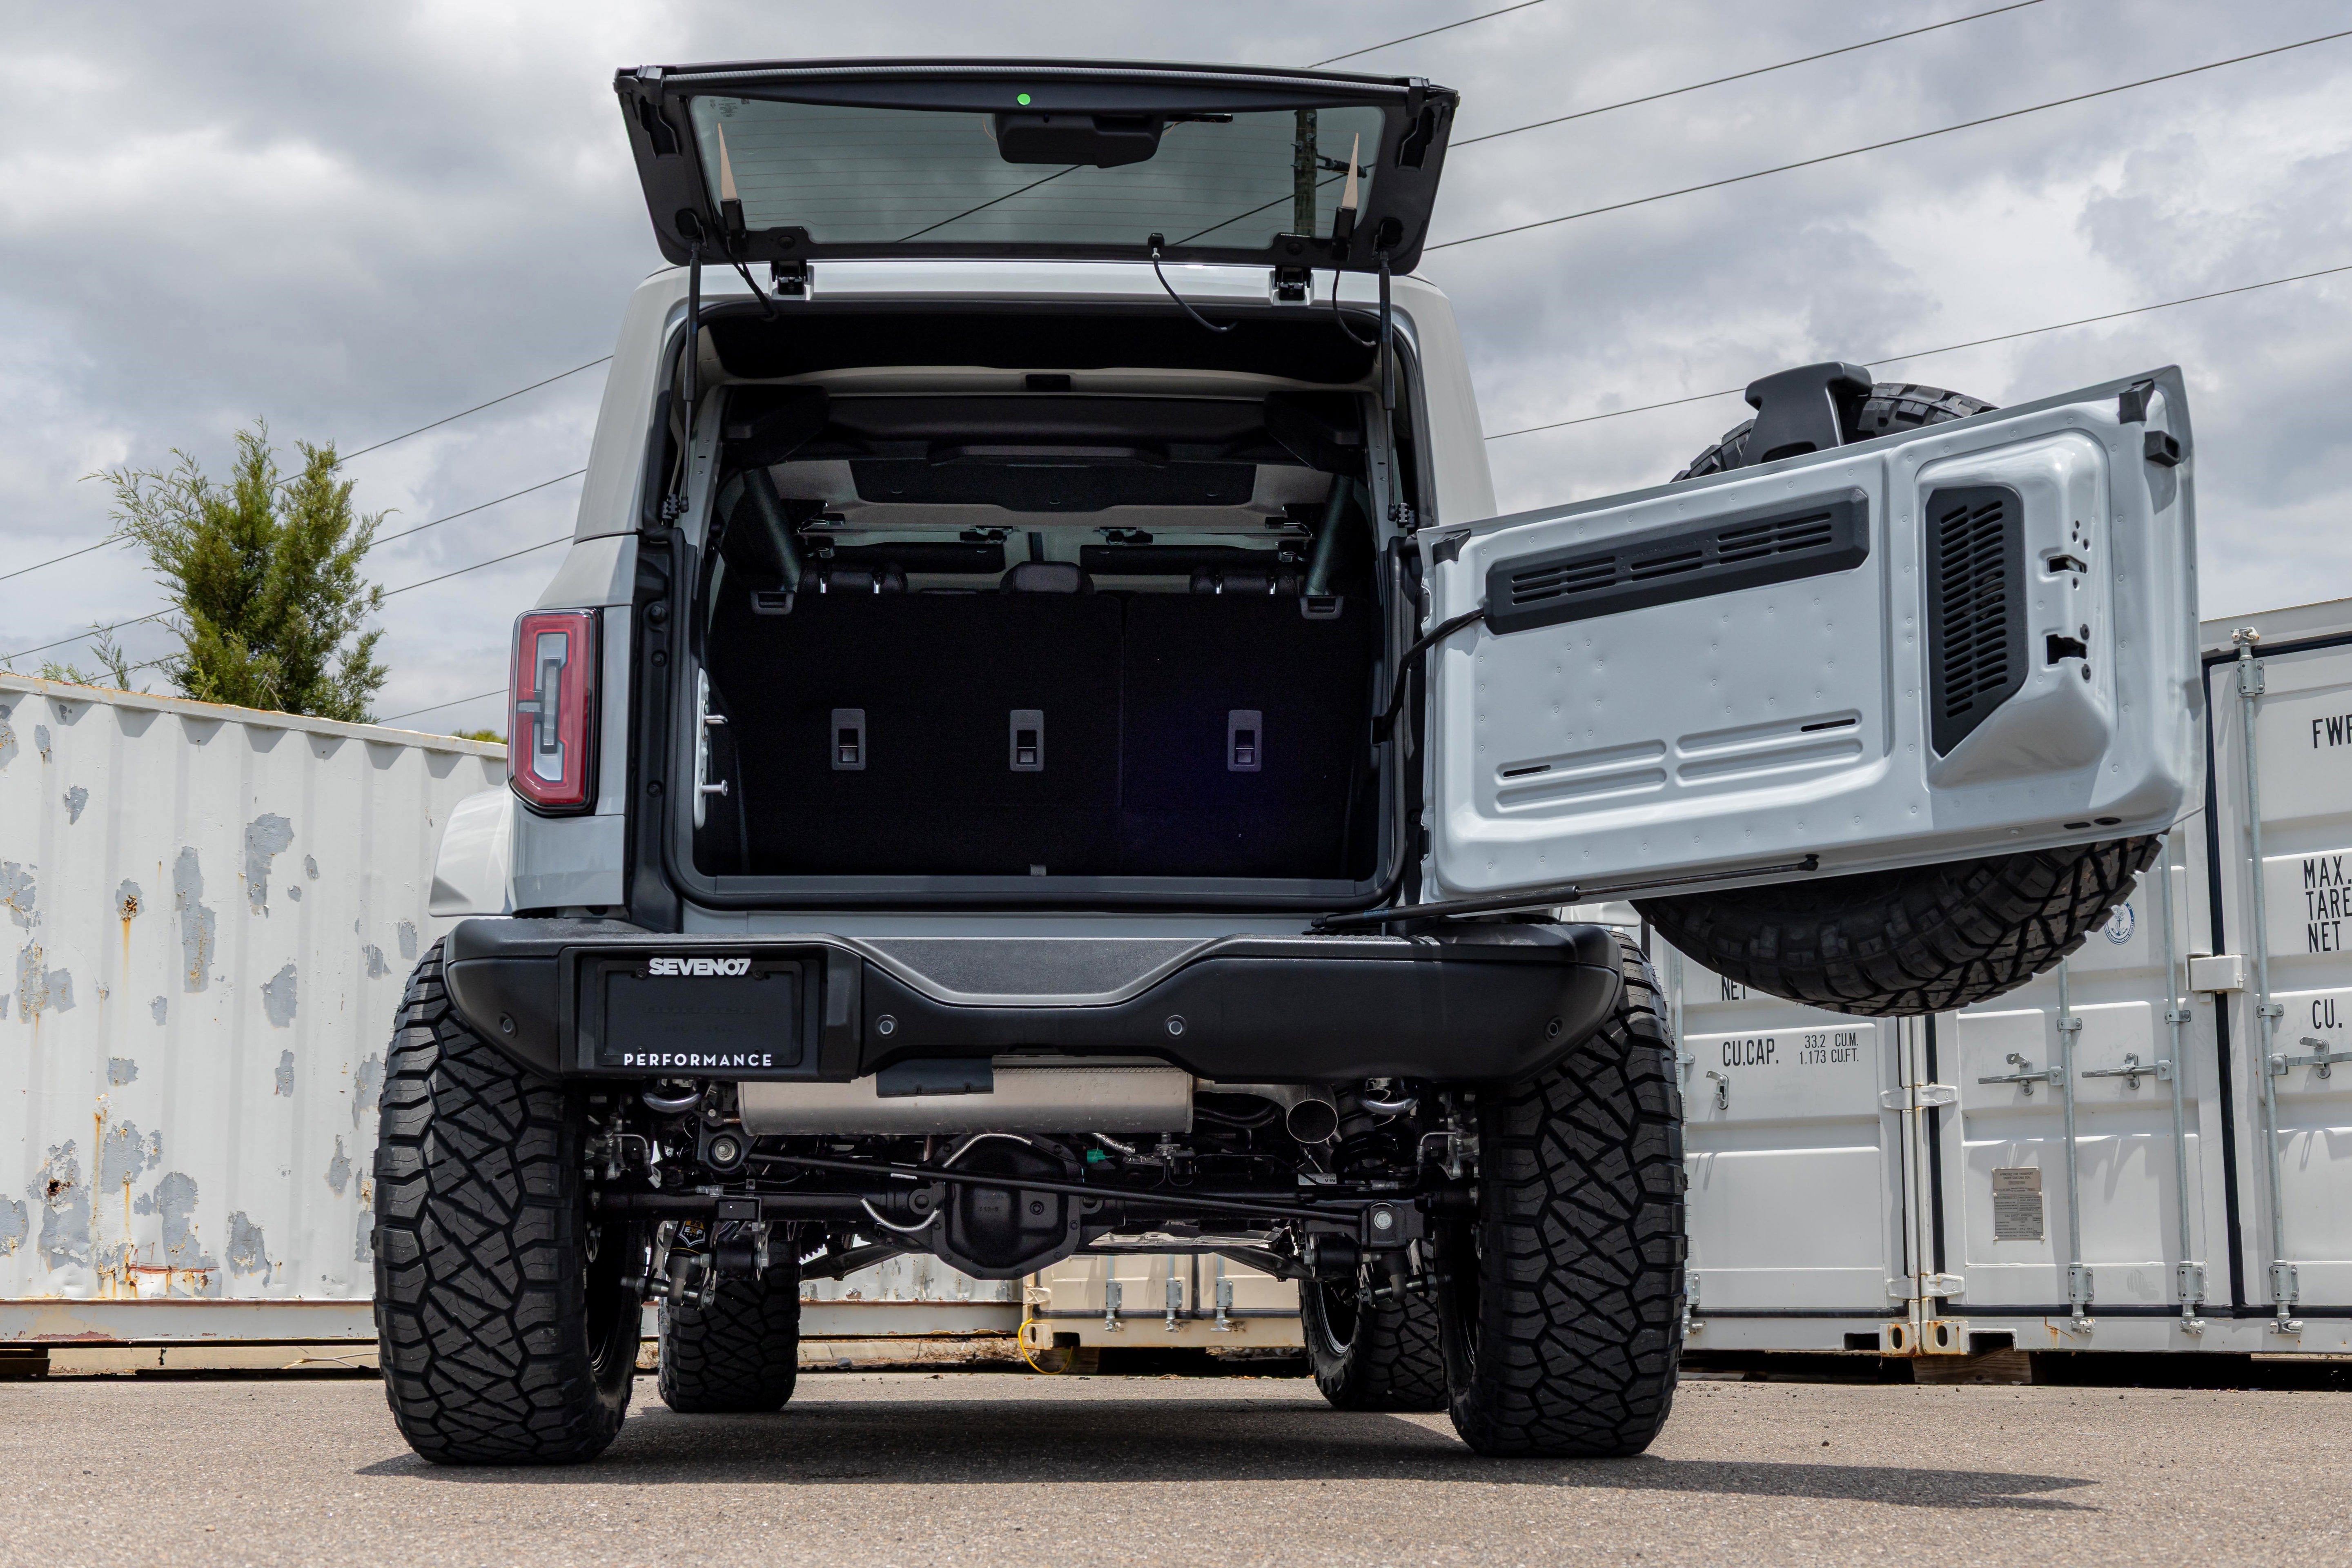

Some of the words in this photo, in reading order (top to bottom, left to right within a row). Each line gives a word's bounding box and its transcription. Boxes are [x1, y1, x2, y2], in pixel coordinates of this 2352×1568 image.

[2303, 855, 2352, 889] MAX.
[2305, 887, 2352, 921] TARE
[2307, 920, 2341, 953] NET
[1805, 1034, 1826, 1049] 33.2
[1835, 1032, 1858, 1047] CU.M.
[624, 1054, 772, 1067] PERFORMANCE
[1831, 1048, 1859, 1063] CU.FT.
[684, 1226, 703, 1235] EXP
